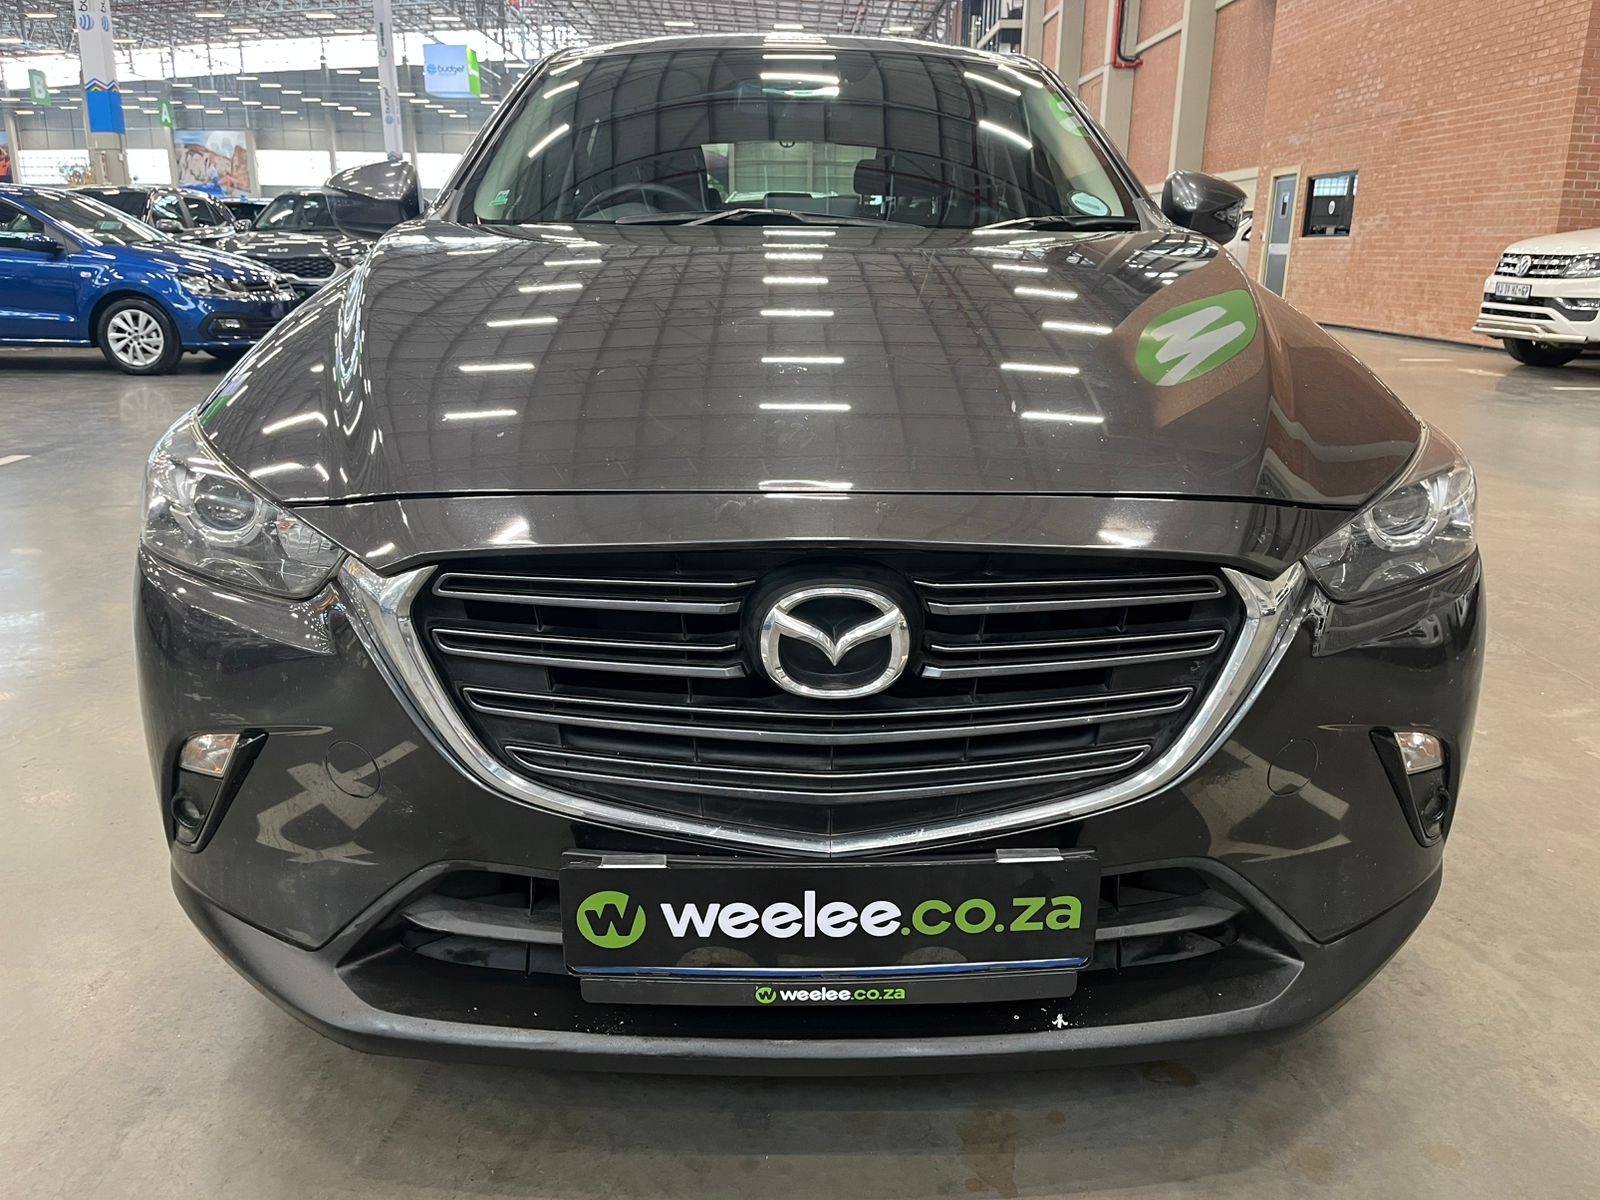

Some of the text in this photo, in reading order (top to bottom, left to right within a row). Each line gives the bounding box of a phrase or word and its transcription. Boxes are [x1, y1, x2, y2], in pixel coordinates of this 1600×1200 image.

[33, 74, 46, 99] B
[161, 103, 171, 123] A
[659, 890, 1083, 940] weelee.co.za
[779, 986, 906, 1002] weelee.co.za
